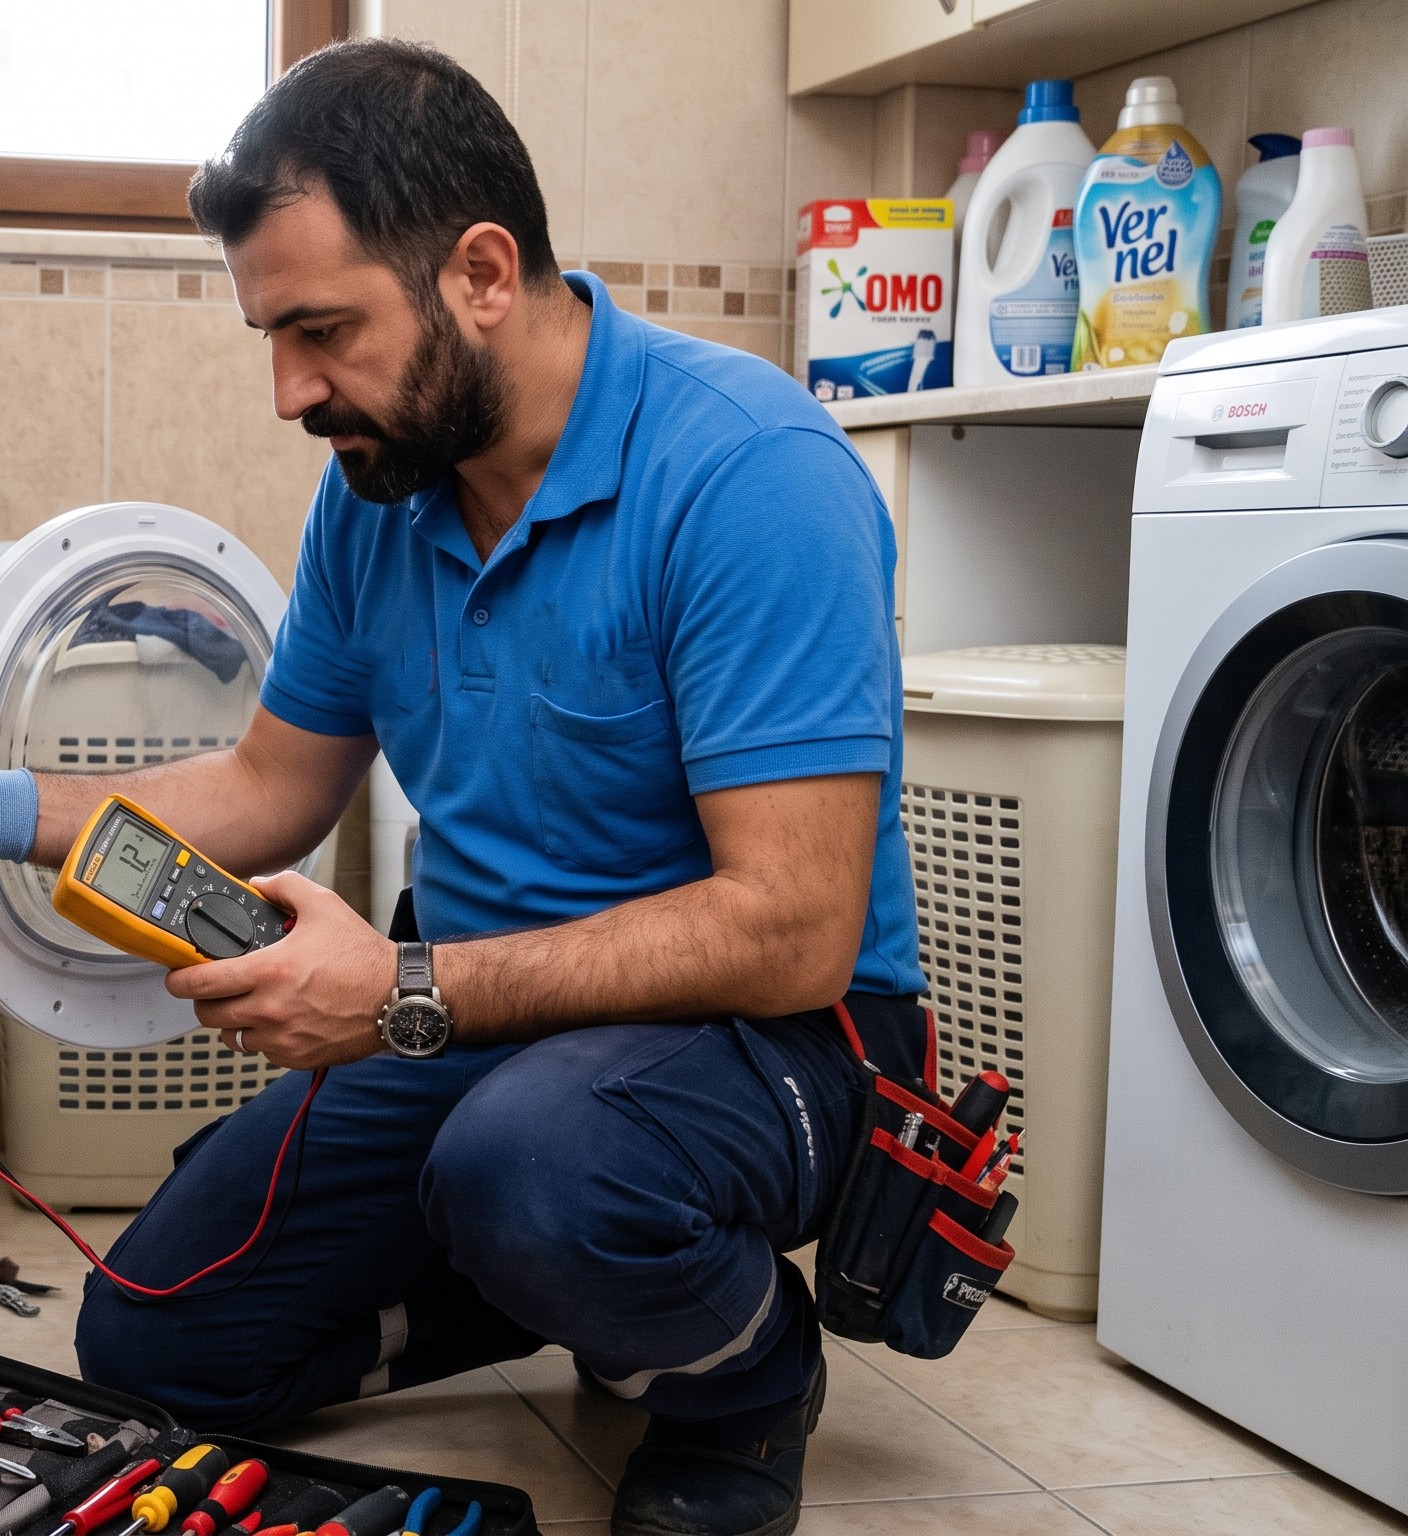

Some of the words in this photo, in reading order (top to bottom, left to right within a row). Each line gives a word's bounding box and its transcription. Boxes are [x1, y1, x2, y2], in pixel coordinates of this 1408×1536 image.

[1099, 201, 1168, 249] Ver
[1114, 228, 1178, 283] nel
[866, 273, 943, 314] OMO
[1227, 402, 1268, 419] BOSCH
